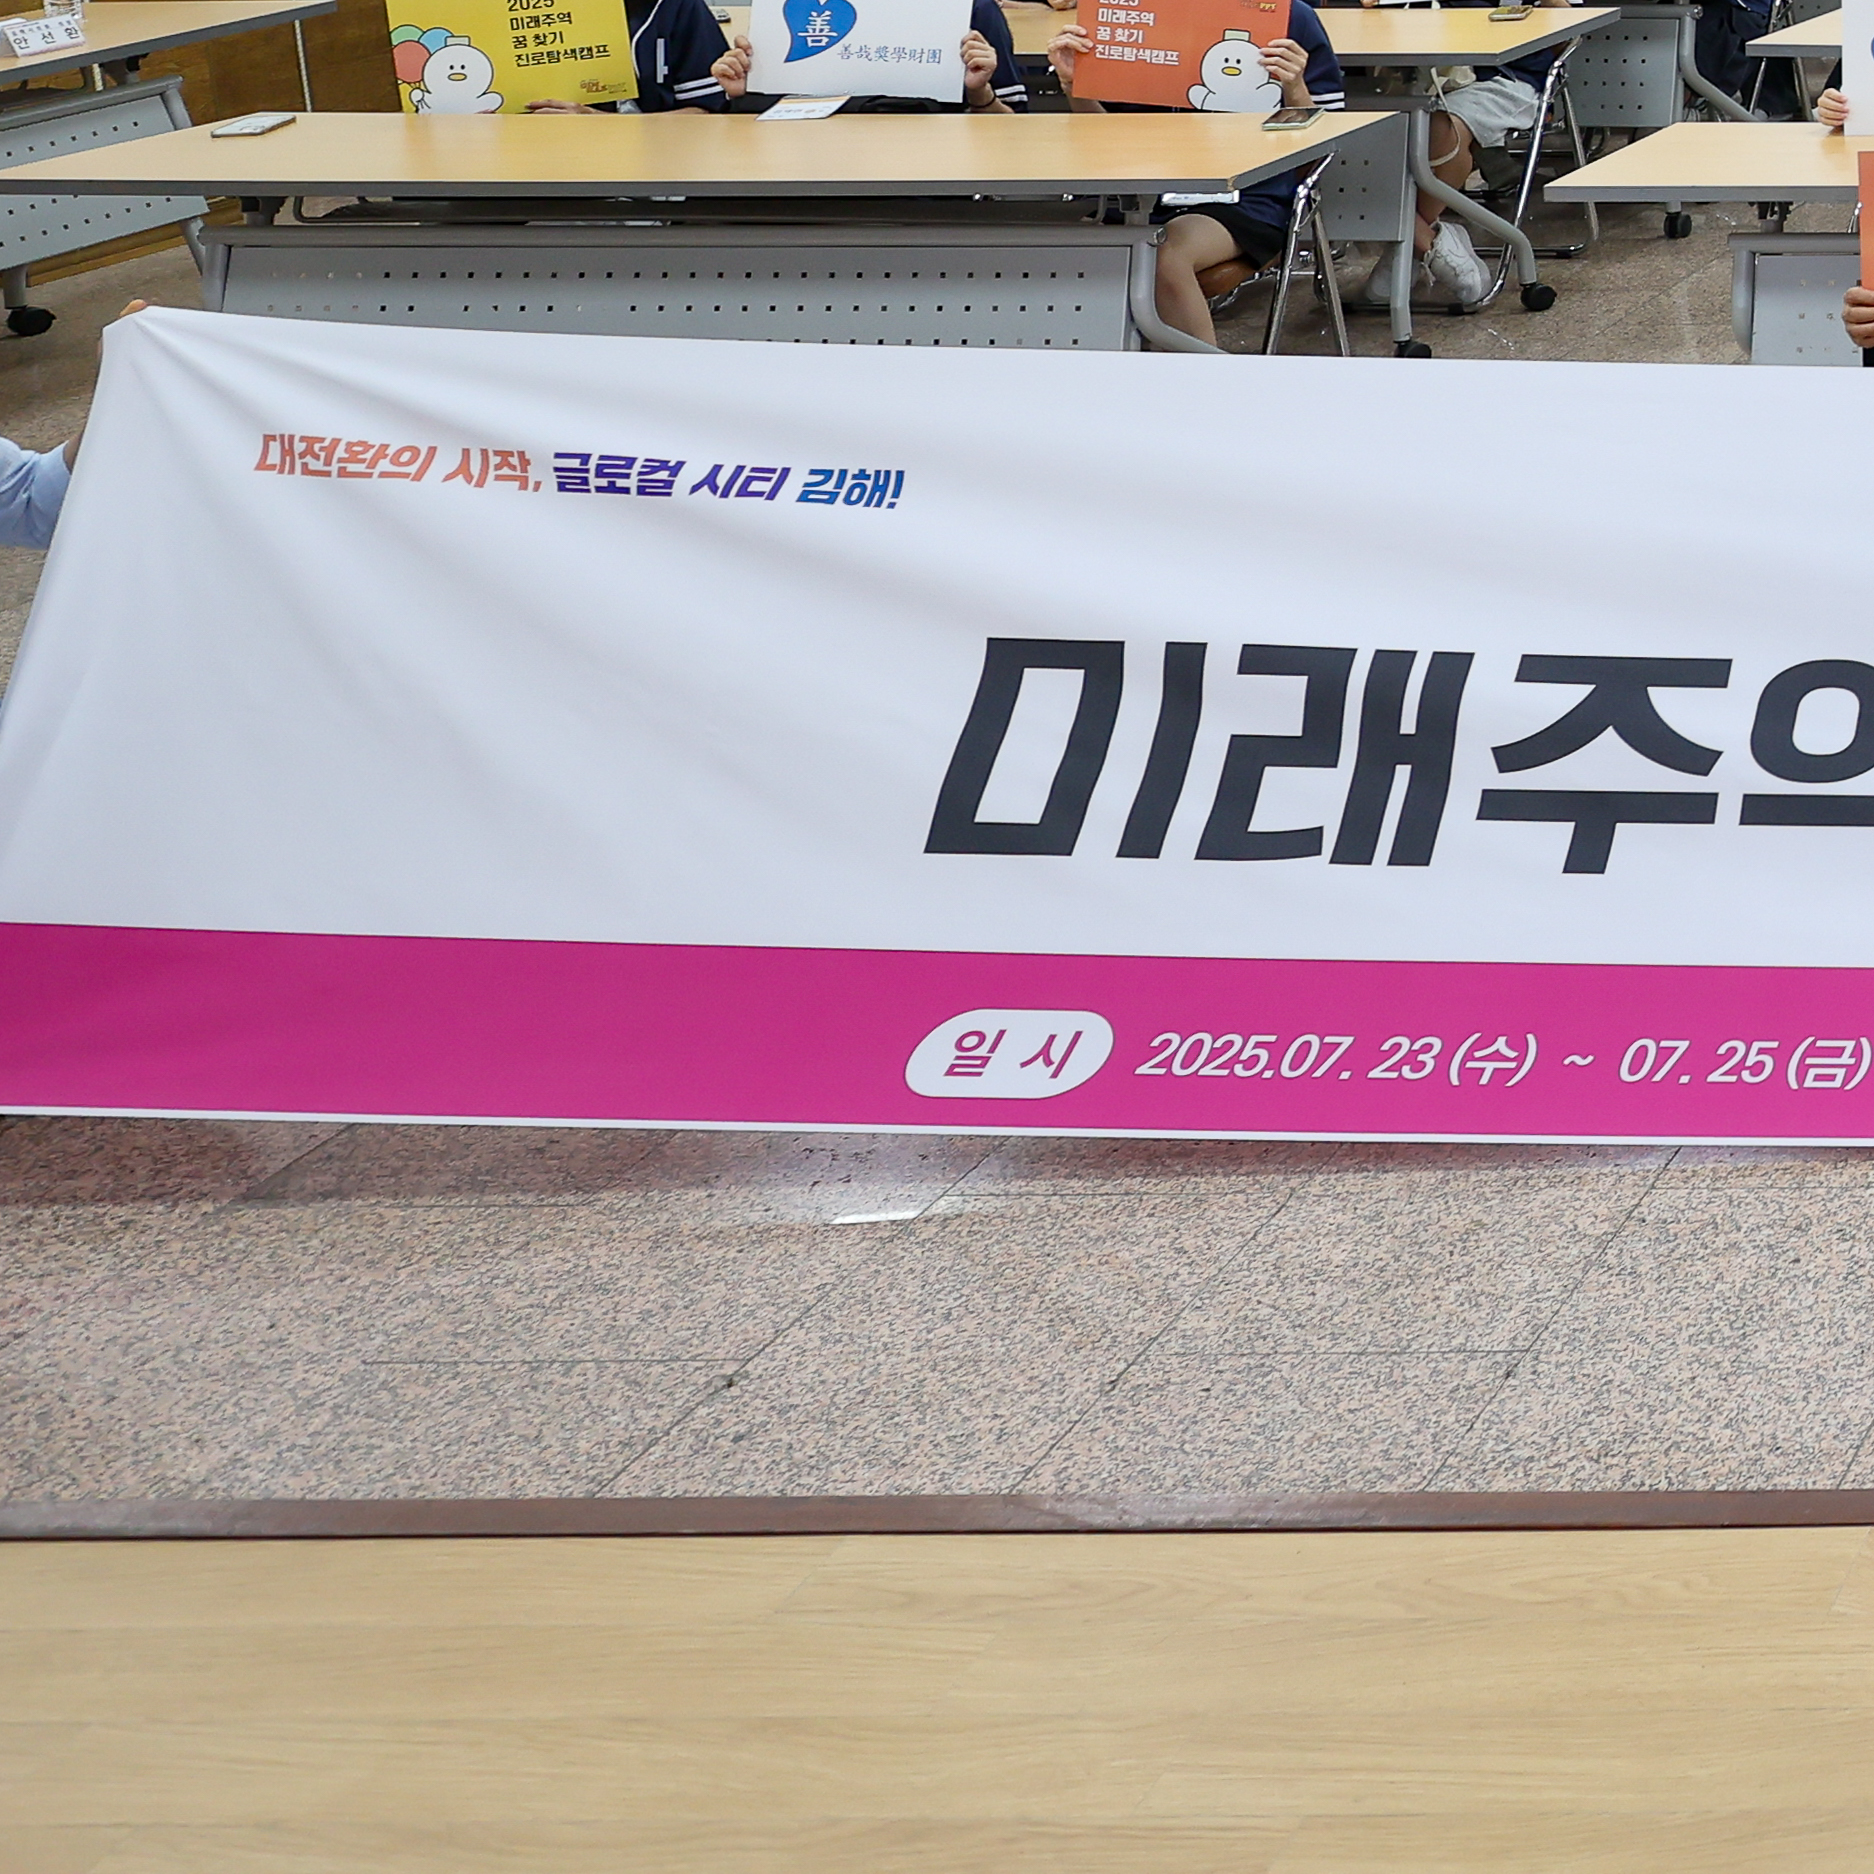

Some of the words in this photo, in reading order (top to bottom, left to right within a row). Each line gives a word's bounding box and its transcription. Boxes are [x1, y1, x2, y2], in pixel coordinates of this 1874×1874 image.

[510, 12, 572, 30] 미래주역
[1097, 8, 1155, 26] 미래주역
[797, 10, 838, 48] 善
[1097, 26, 1111, 40] 꿈
[1115, 28, 1143, 43] 찾기
[513, 35, 527, 49] 꿈
[533, 31, 563, 47] 찾기
[515, 45, 610, 67] 진로탐색캠프
[1096, 45, 1179, 66] 진로탐색캠프
[254, 434, 437, 481] 대전환의
[443, 448, 542, 492] 시작,
[553, 453, 686, 496] 글로컬
[689, 464, 791, 500] 시티
[796, 469, 905, 509] 김해!
[1135, 1033, 1354, 1079] 2025.07.
[1620, 1039, 1690, 1083] 07.
